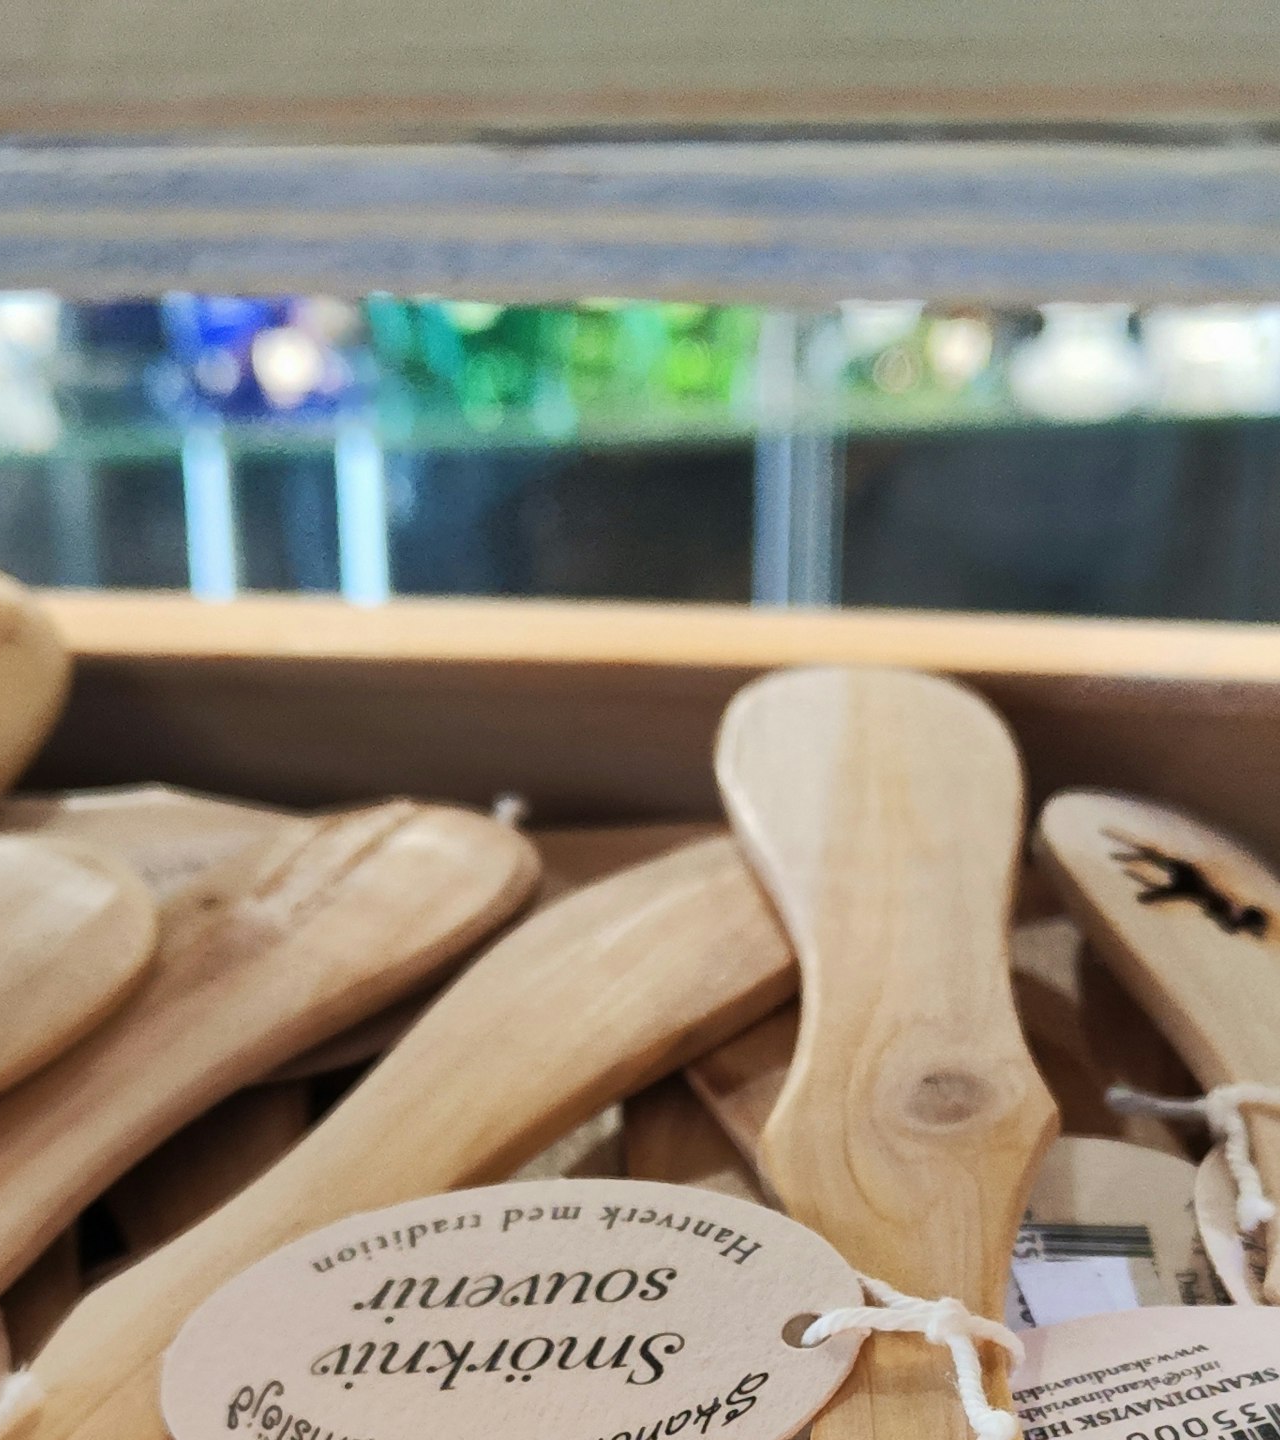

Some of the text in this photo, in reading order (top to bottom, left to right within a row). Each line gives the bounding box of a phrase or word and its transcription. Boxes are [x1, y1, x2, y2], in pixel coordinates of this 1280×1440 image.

[309, 1204, 764, 1276] Hantverk med tradition
[352, 1266, 679, 1325] souvenir
[312, 1316, 686, 1392] Smörkniv
[1079, 1367, 1280, 1431] SKANDINAVISK
